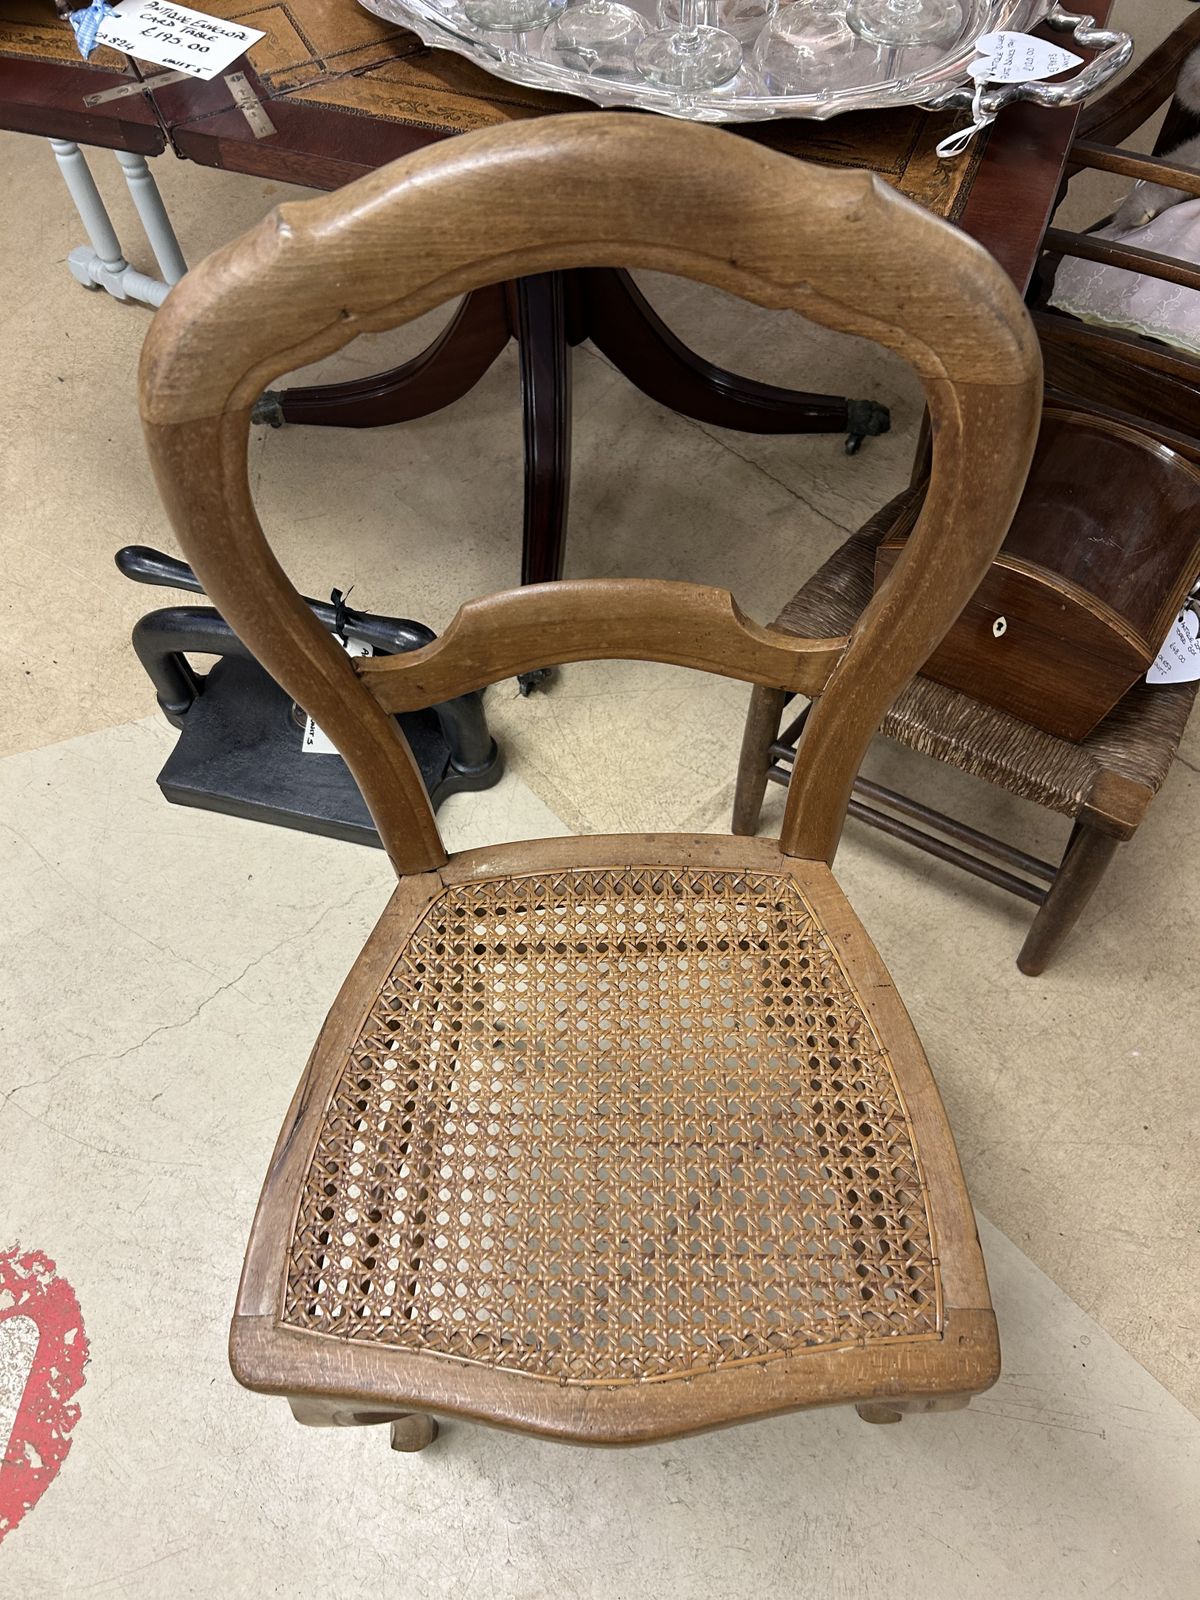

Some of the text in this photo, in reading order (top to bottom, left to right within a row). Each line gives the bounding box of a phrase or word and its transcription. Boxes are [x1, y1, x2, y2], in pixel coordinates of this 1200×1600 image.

[144, 1, 192, 24] ANTIQUE
[140, 13, 219, 42] CARD TABLE
[141, 26, 210, 53] £195.00
[162, 57, 196, 69] UNIT
